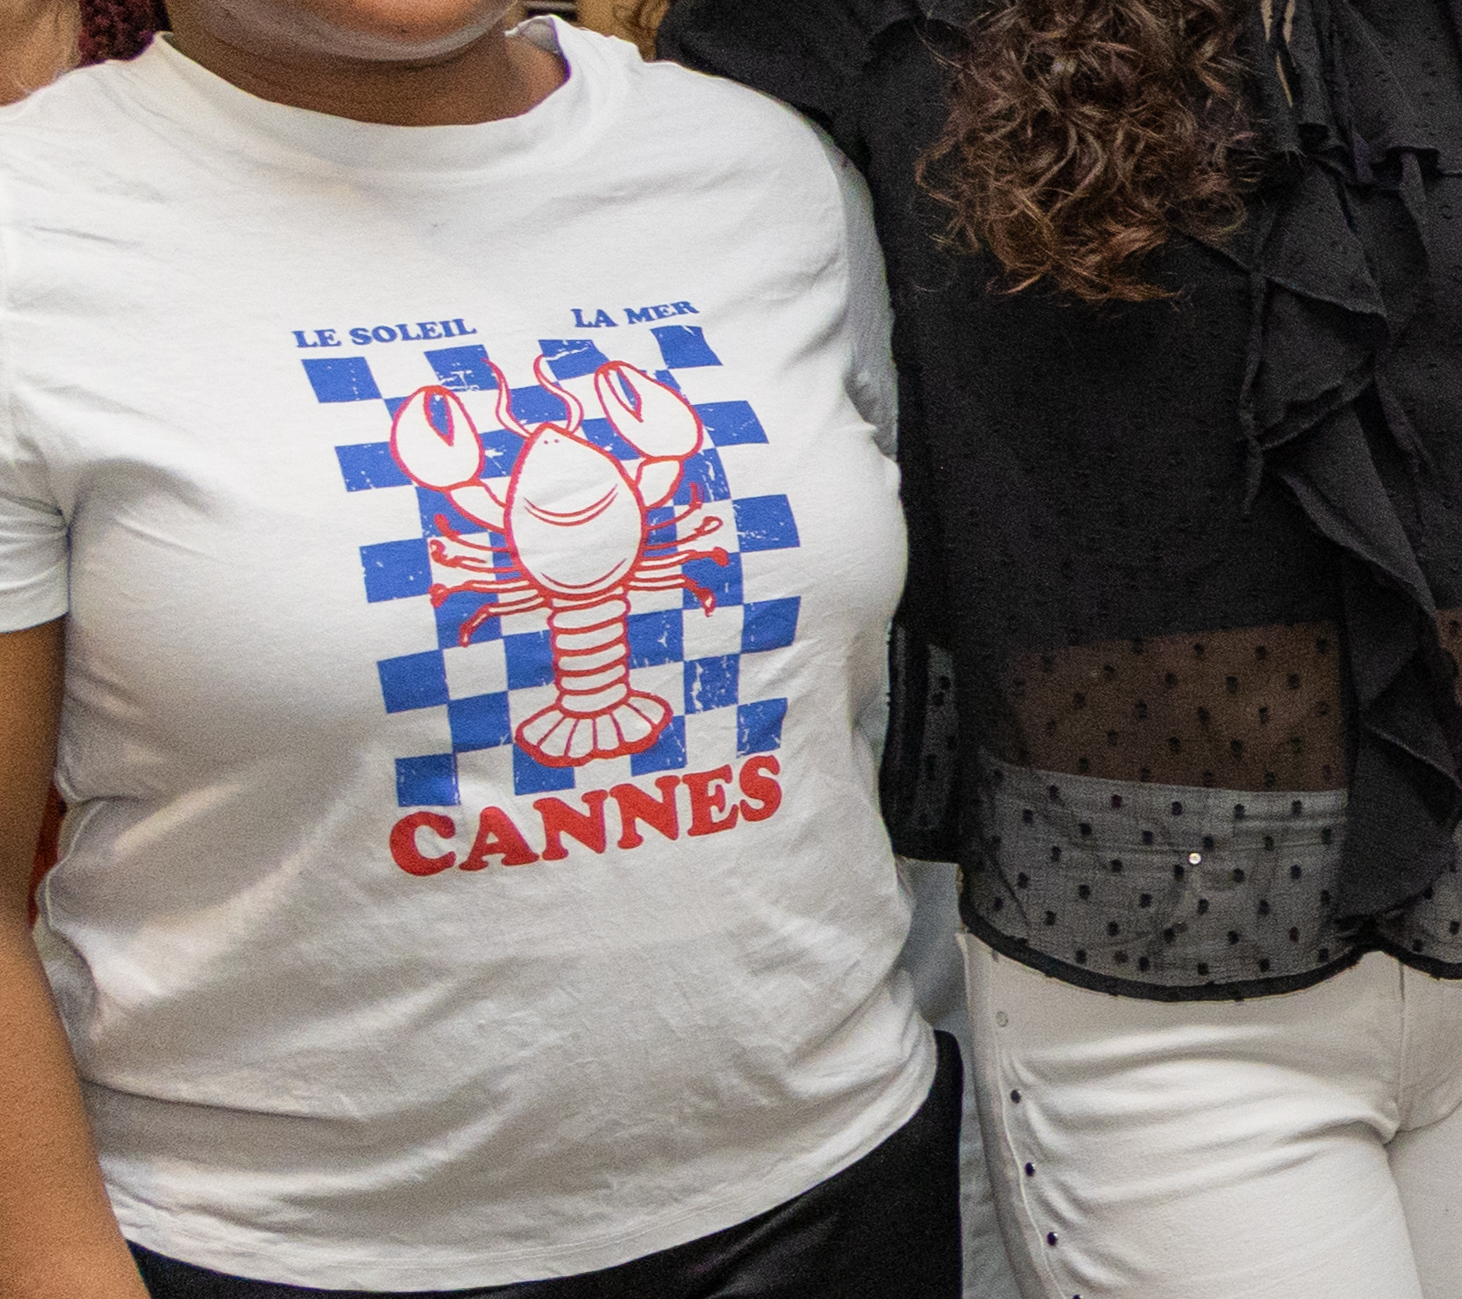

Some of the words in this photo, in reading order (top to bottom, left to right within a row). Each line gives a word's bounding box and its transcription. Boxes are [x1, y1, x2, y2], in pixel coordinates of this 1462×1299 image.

[571, 307, 618, 330] LA
[624, 300, 701, 326] MER
[293, 328, 342, 349] LE
[349, 318, 477, 348] SOLEIL
[388, 754, 784, 878] CANNES
